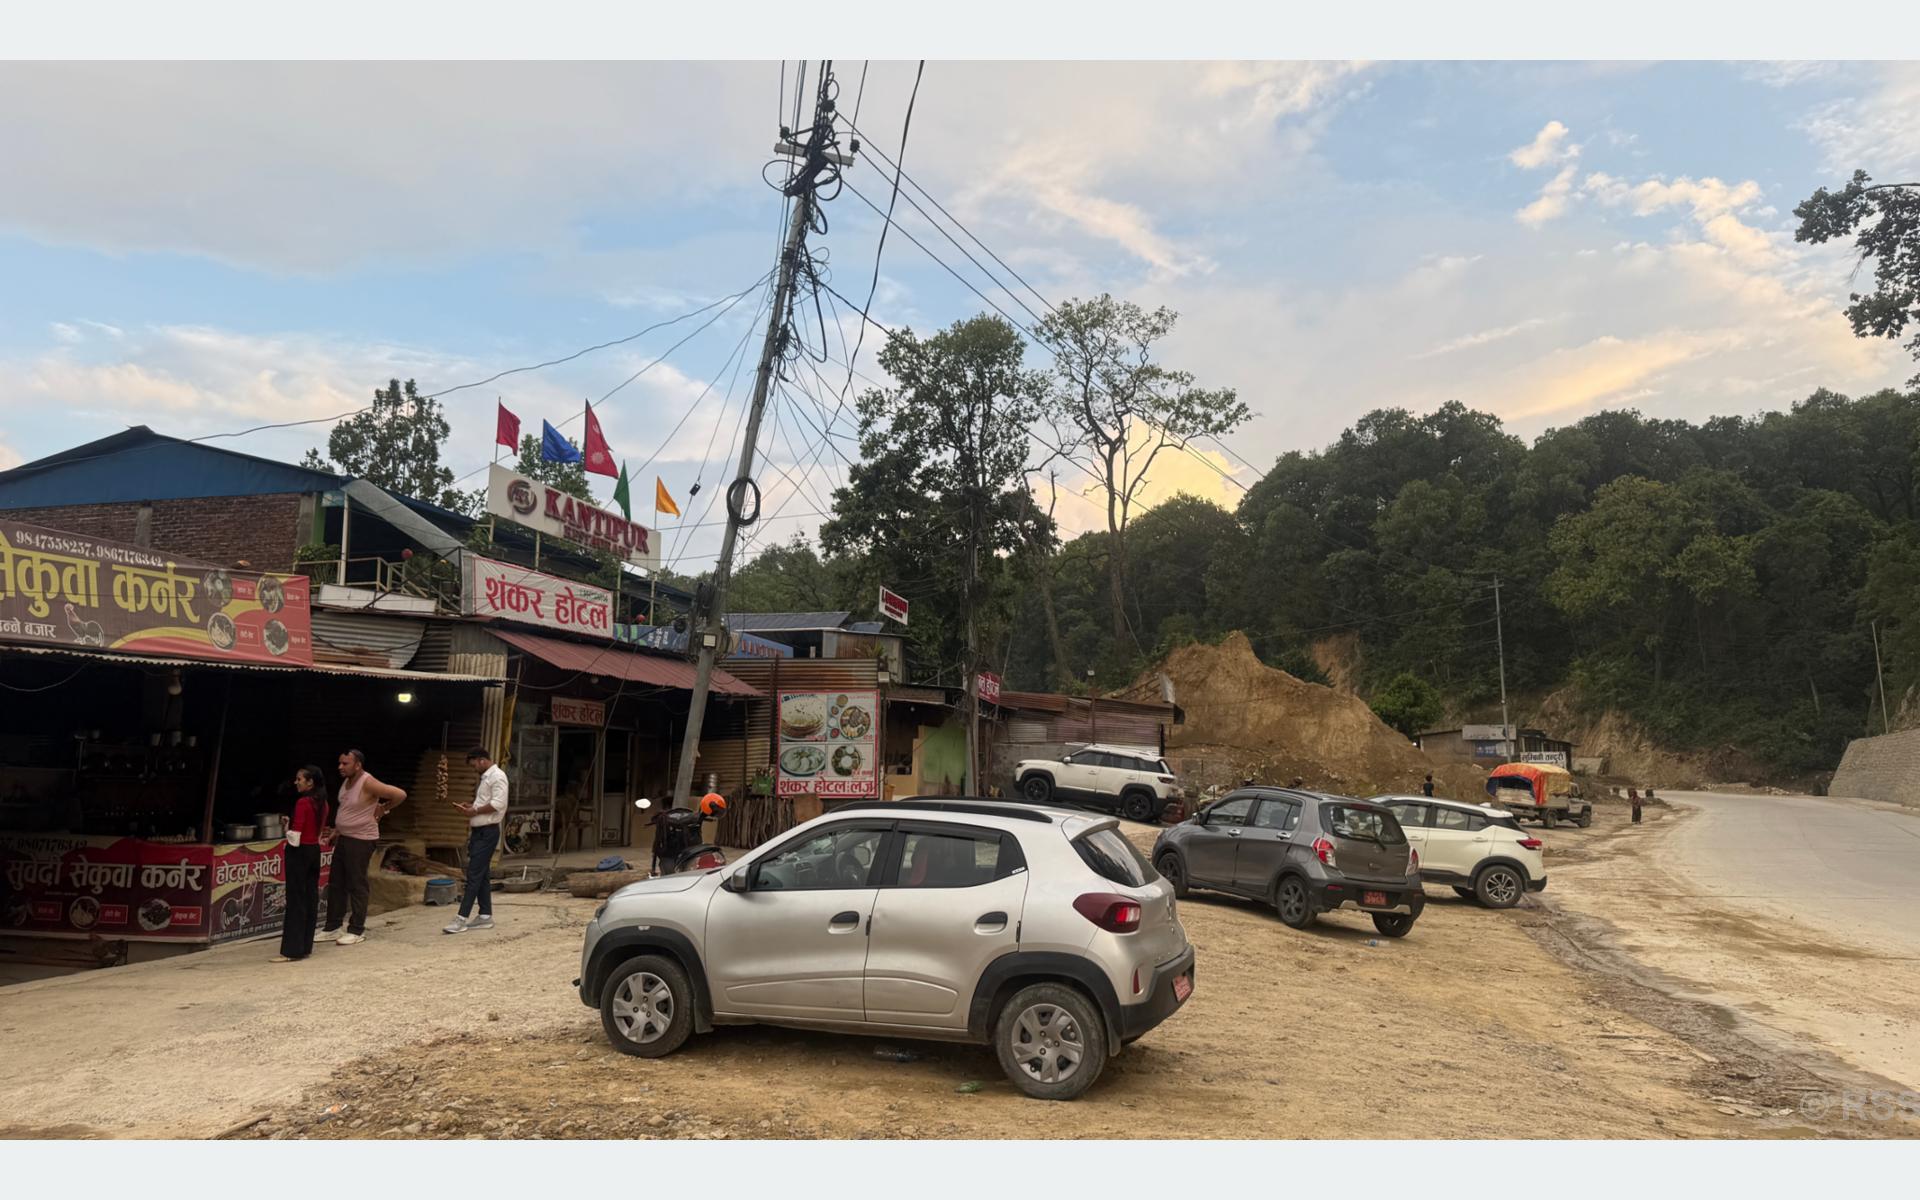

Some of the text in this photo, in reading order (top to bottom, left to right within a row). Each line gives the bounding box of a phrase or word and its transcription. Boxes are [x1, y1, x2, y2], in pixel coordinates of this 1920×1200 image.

[544, 487, 650, 554] KANTIPUR
[112, 561, 201, 624] कर्नर
[485, 574, 608, 630] शंकर होटल
[25, 622, 57, 638] बजार
[579, 702, 603, 722] होटल
[780, 777, 809, 793] शंकर
[6, 855, 207, 894] सुवेदी सेकुवा कर्नर
[216, 861, 249, 885] होटल
[253, 853, 282, 882] सुवेदी
